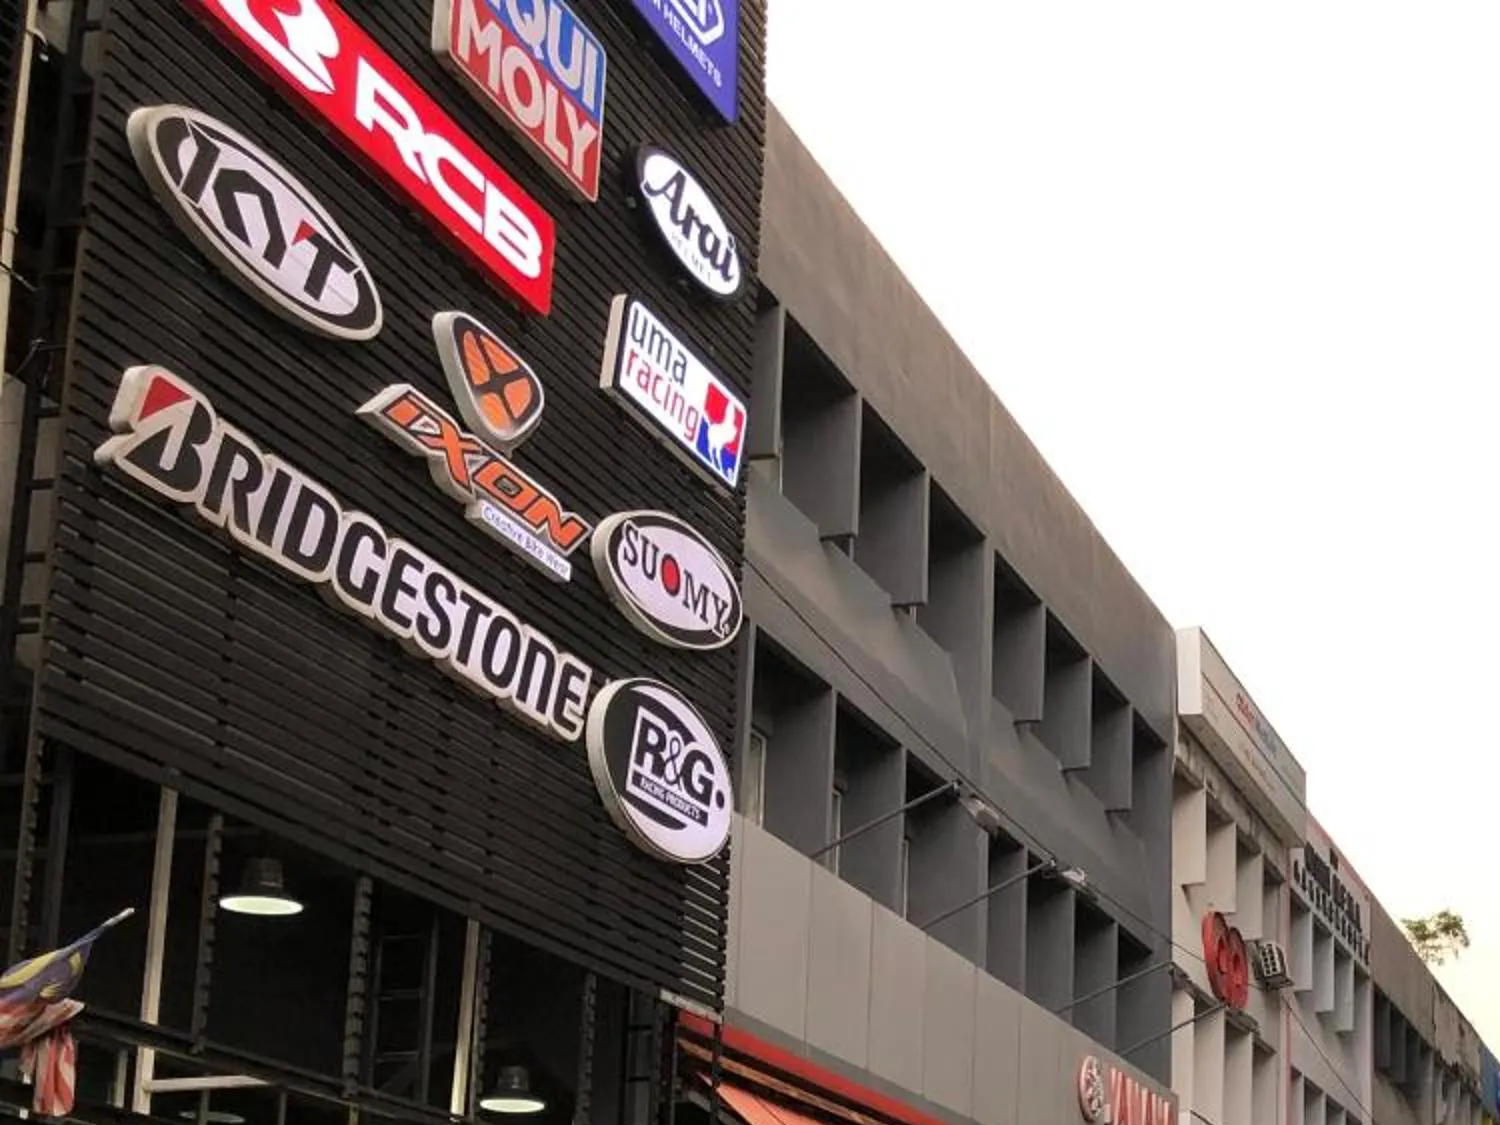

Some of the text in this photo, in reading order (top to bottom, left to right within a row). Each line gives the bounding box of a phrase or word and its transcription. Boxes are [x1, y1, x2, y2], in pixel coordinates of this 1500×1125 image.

[457, 0, 597, 182] MOLY
[489, 0, 599, 105] QUI
[663, 2, 721, 88] HELMETS
[181, 118, 358, 302] KYT
[353, 55, 541, 279] RCB
[643, 169, 735, 283] Arai
[625, 344, 699, 439] racing
[630, 298, 688, 384] uma
[115, 376, 591, 737] BRIDGESTONE
[623, 522, 728, 637] SUOMY
[634, 714, 716, 808] R&G
